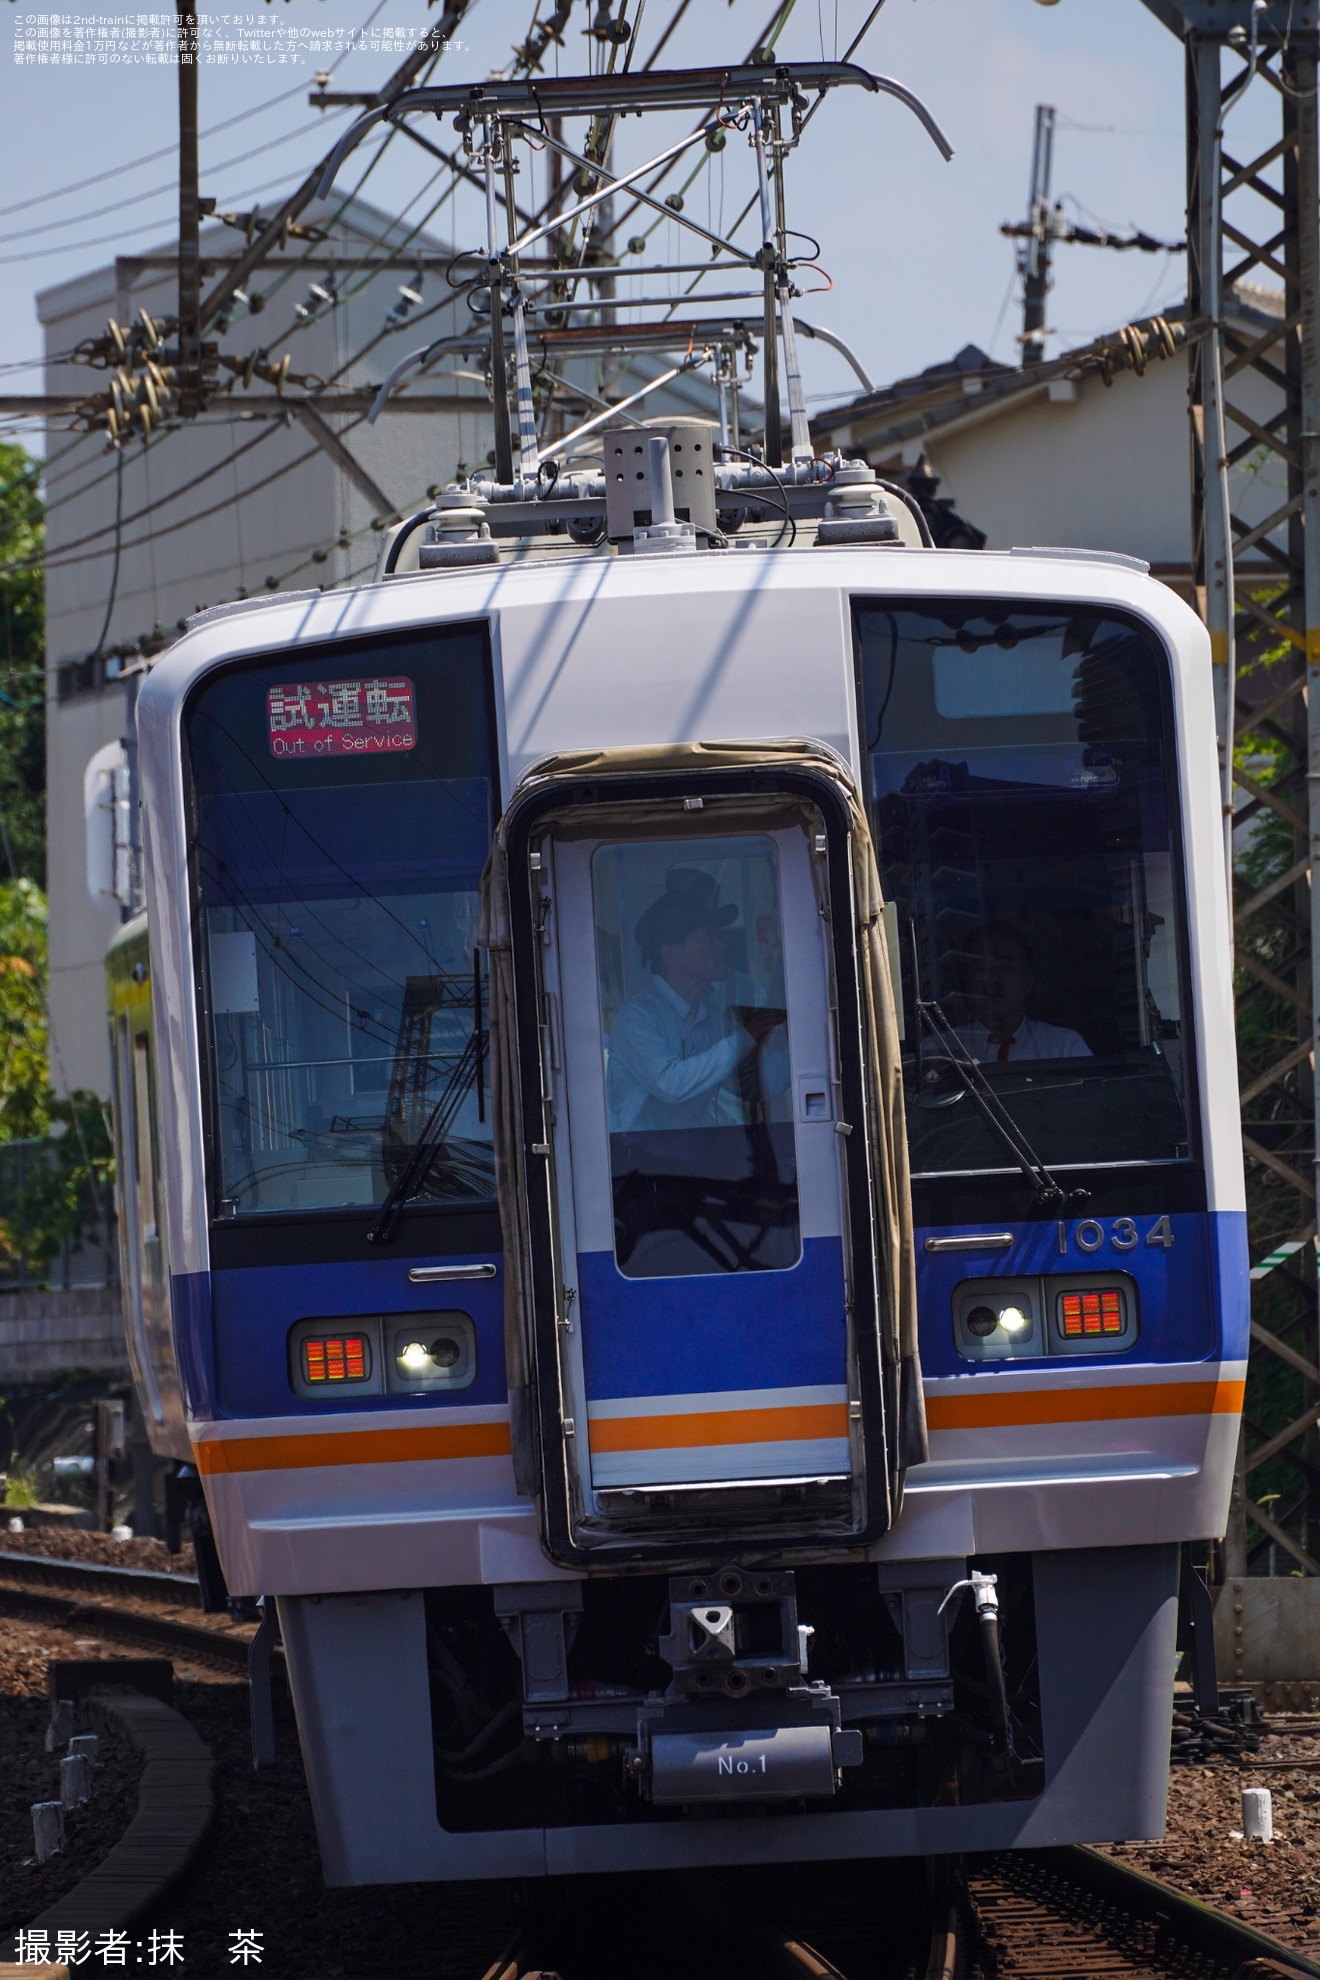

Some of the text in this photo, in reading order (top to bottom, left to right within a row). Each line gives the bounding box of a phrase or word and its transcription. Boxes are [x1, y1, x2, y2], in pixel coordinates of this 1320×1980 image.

[269, 680, 411, 732] 試運転
[273, 731, 413, 754] Out of Service
[1058, 1215, 1175, 1254] 1034
[718, 1754, 766, 1775] No.1
